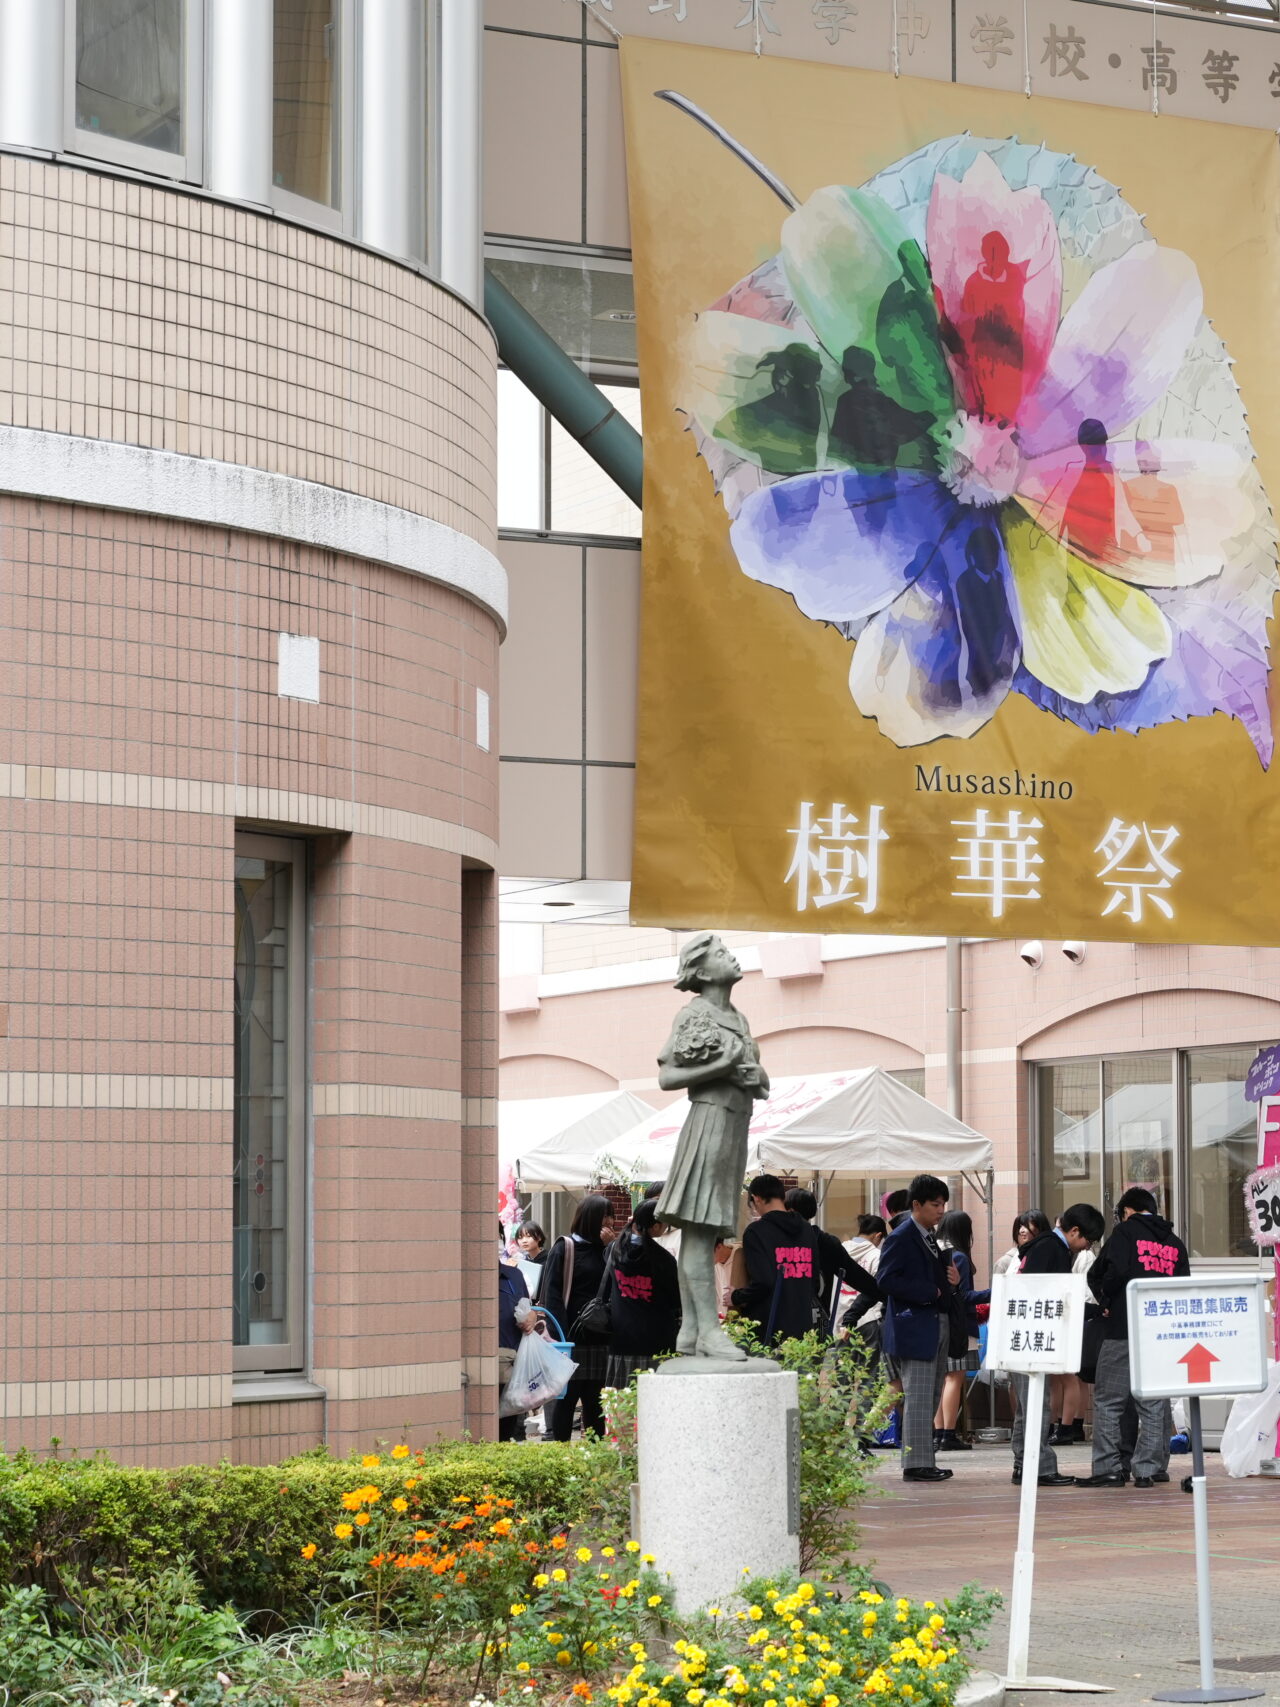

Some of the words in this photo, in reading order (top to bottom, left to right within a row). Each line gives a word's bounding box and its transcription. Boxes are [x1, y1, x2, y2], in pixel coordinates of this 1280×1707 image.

[915, 764, 1073, 800] Musashino
[784, 802, 1181, 922] 樹華祭
[1007, 1298, 1064, 1320] 車両・自転車
[1144, 1296, 1248, 1316] 過去問題集販売
[1010, 1330, 1055, 1351] 進入禁止
